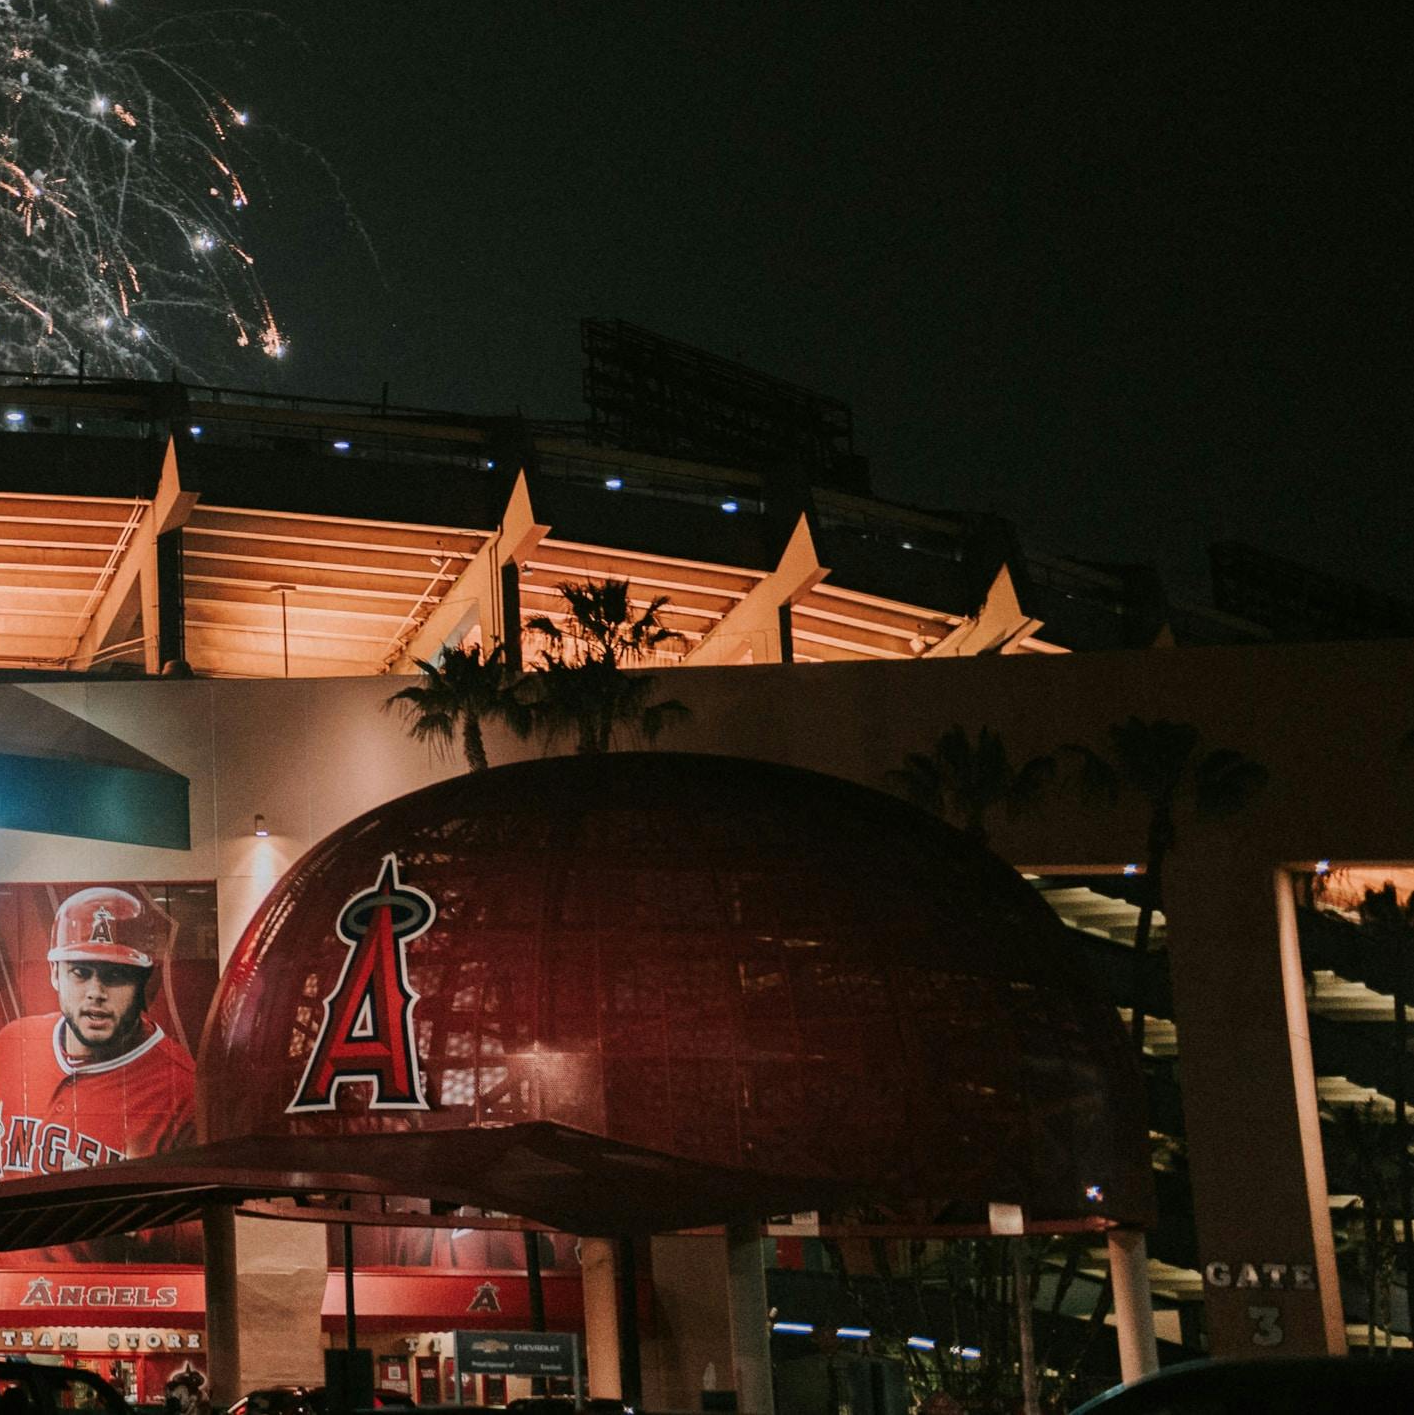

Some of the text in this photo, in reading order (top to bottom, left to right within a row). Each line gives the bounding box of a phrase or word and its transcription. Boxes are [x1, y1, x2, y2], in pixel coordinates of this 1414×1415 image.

[19, 1275, 178, 1308] ANGELS
[1205, 1260, 1317, 1291] GATE
[1, 1330, 201, 1349] TEAM STORE
[1247, 1305, 1284, 1347] 3
